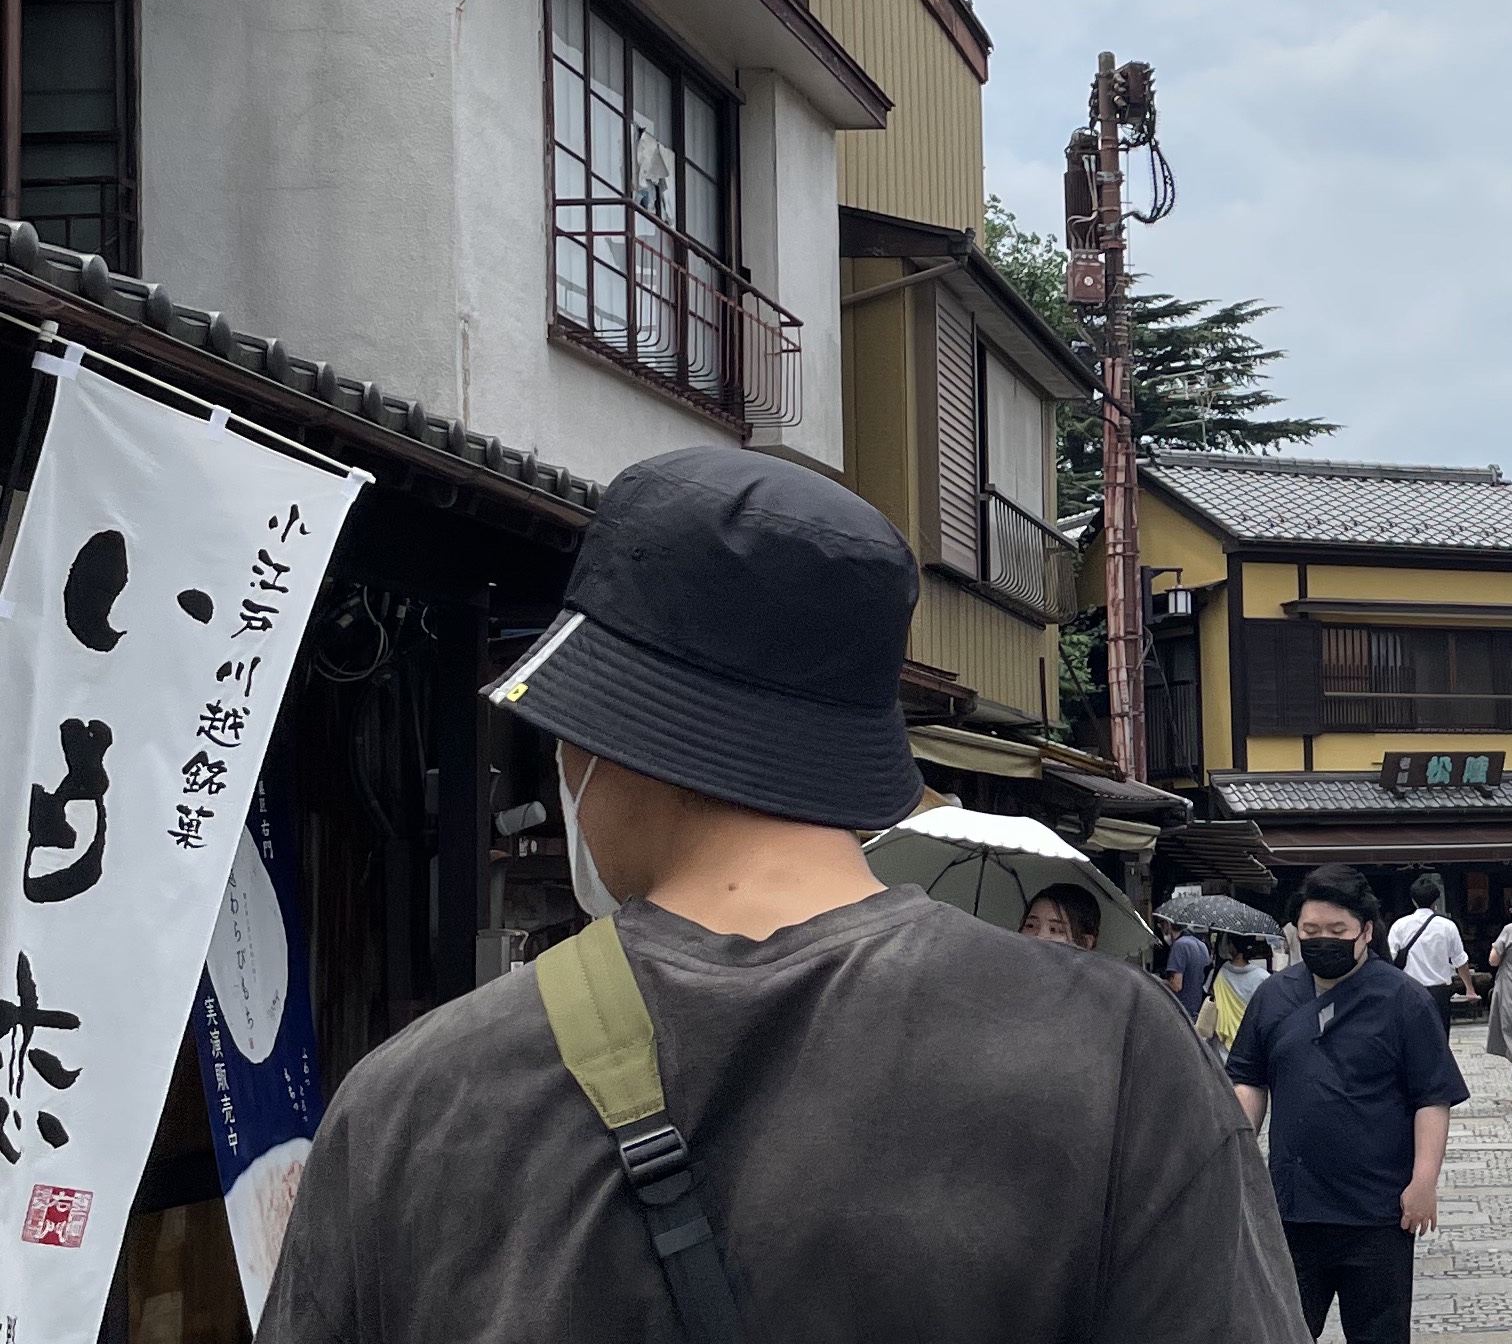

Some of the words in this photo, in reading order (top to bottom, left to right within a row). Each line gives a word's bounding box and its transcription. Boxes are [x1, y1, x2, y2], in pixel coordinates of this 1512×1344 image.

[166, 503, 312, 850] 小江戸川越銘菓
